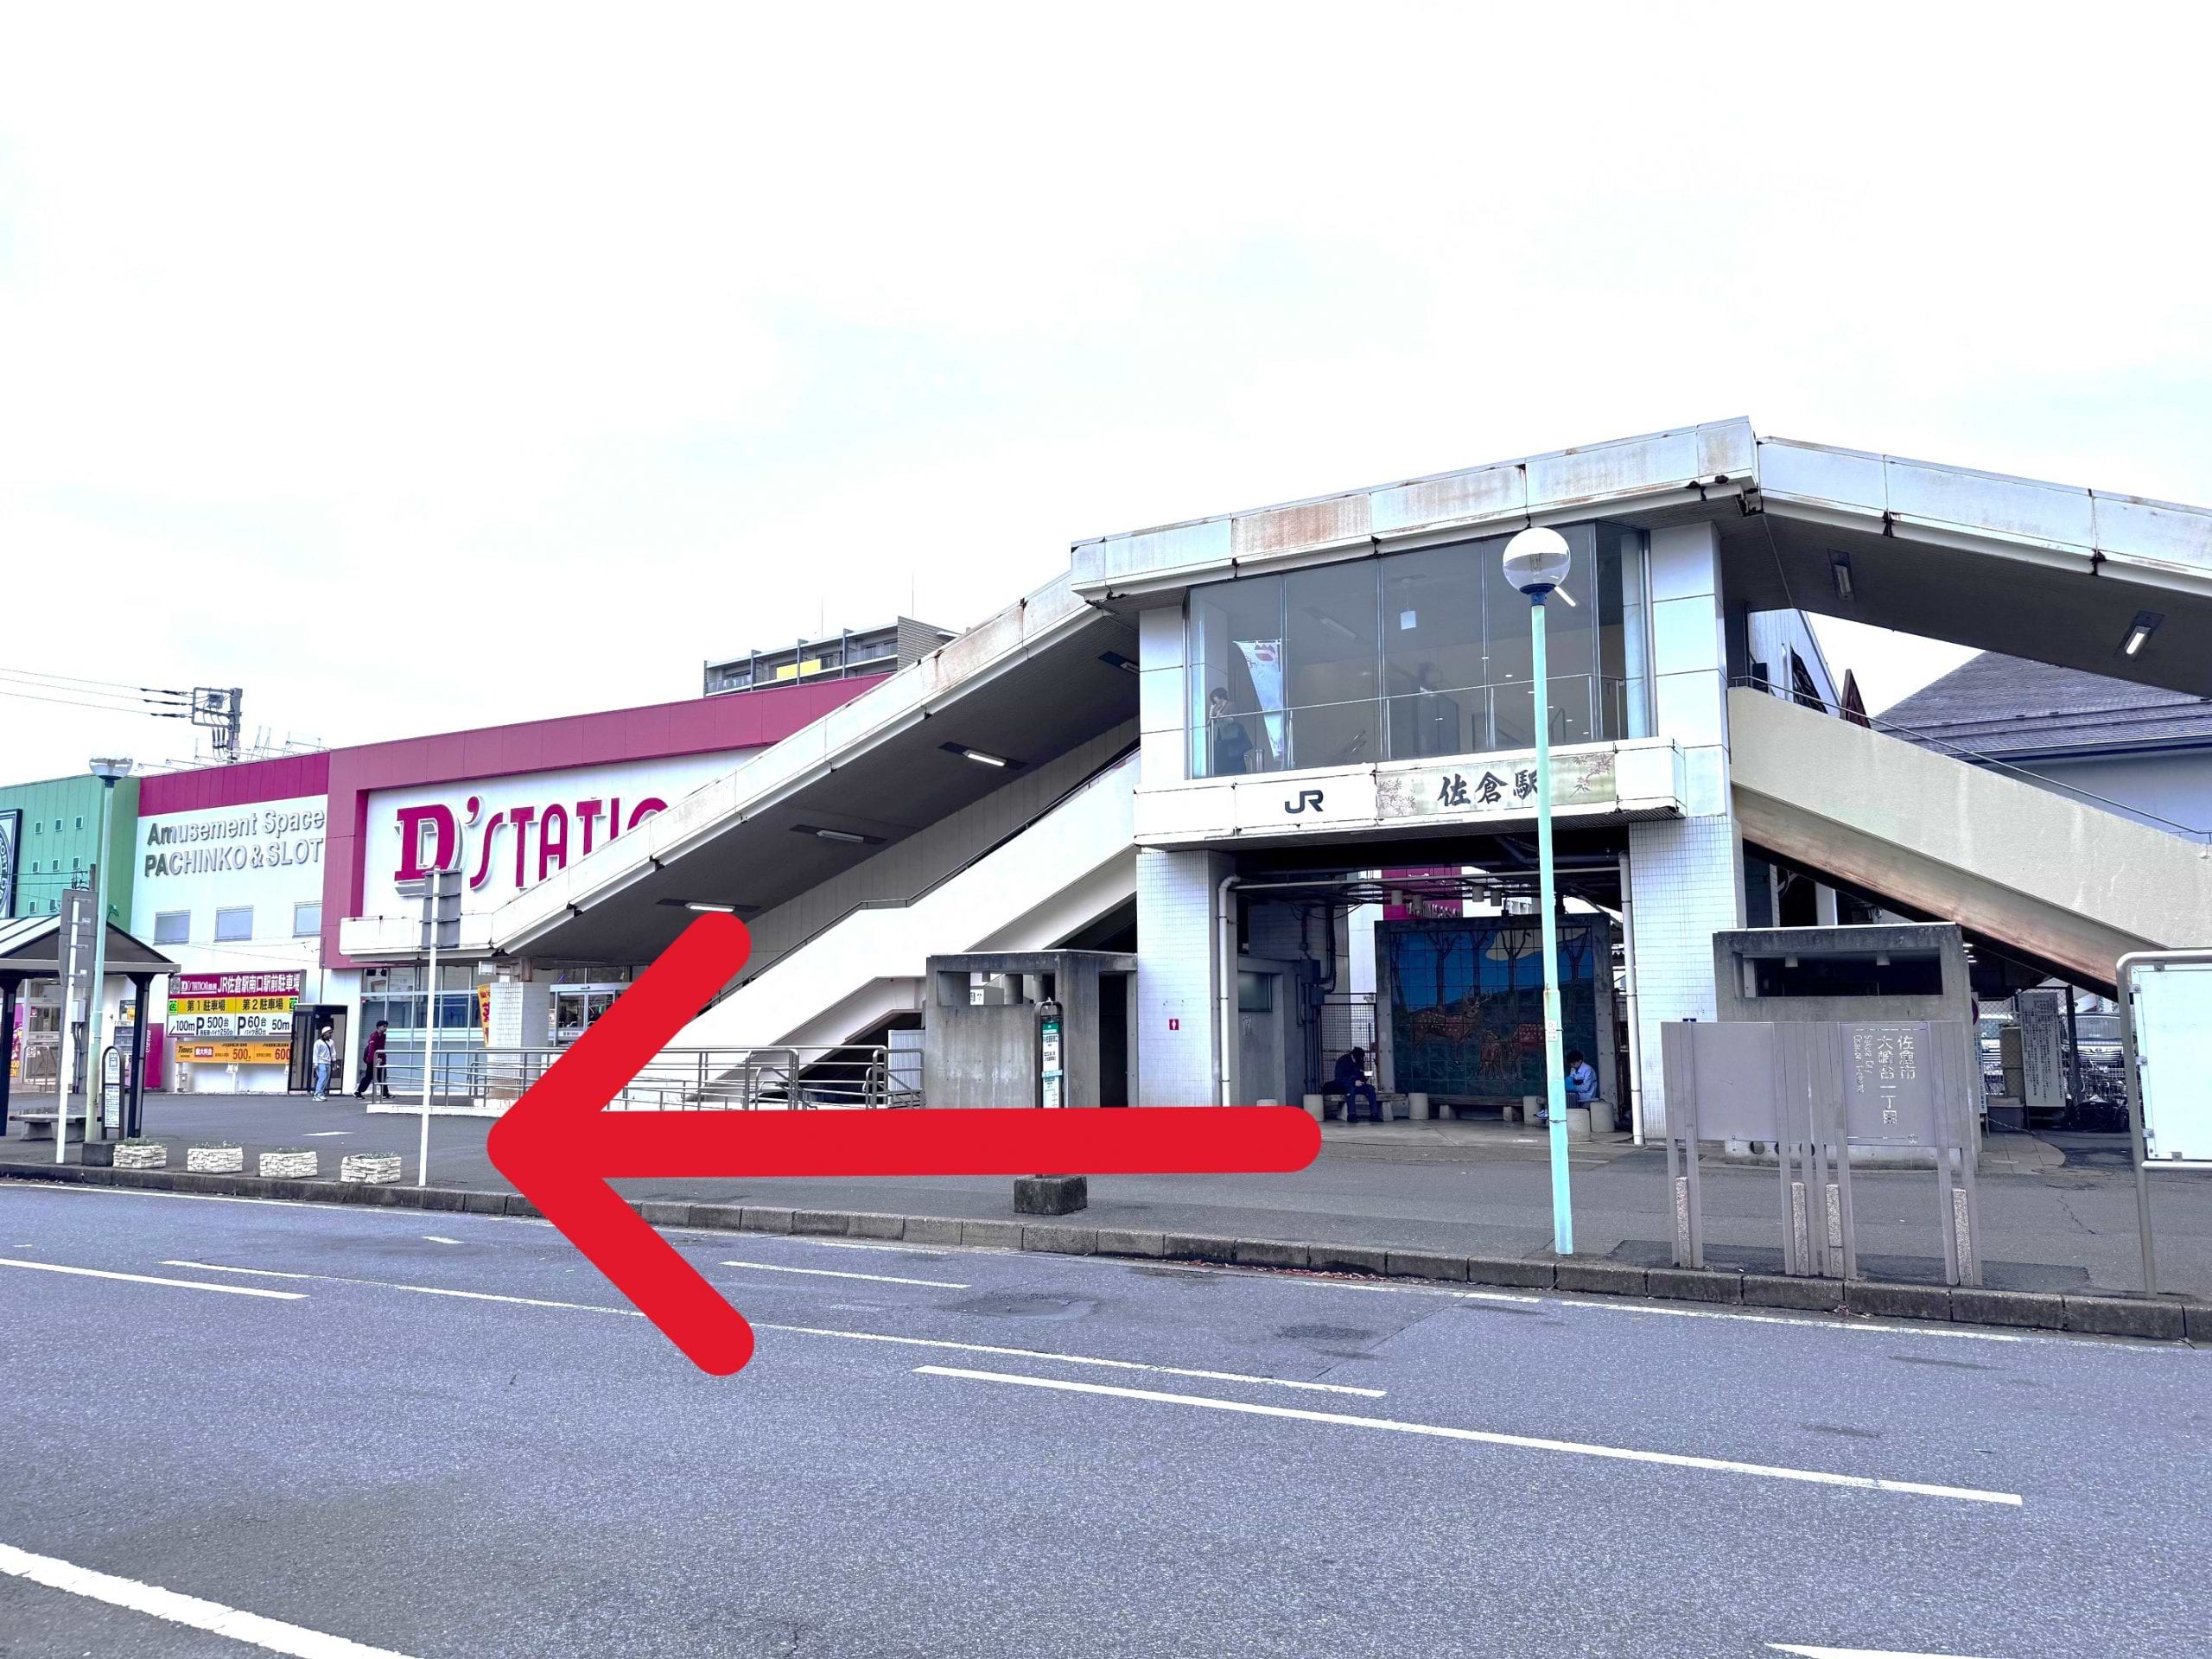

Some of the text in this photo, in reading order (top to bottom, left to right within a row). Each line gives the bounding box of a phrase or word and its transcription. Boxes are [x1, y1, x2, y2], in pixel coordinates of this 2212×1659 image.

[1285, 790, 1324, 814] JR
[147, 809, 326, 846] Amusement Space
[144, 837, 324, 878] PACHINKO & SLOT
[176, 1020, 195, 1032] 100m
[271, 1019, 290, 1031] 50m
